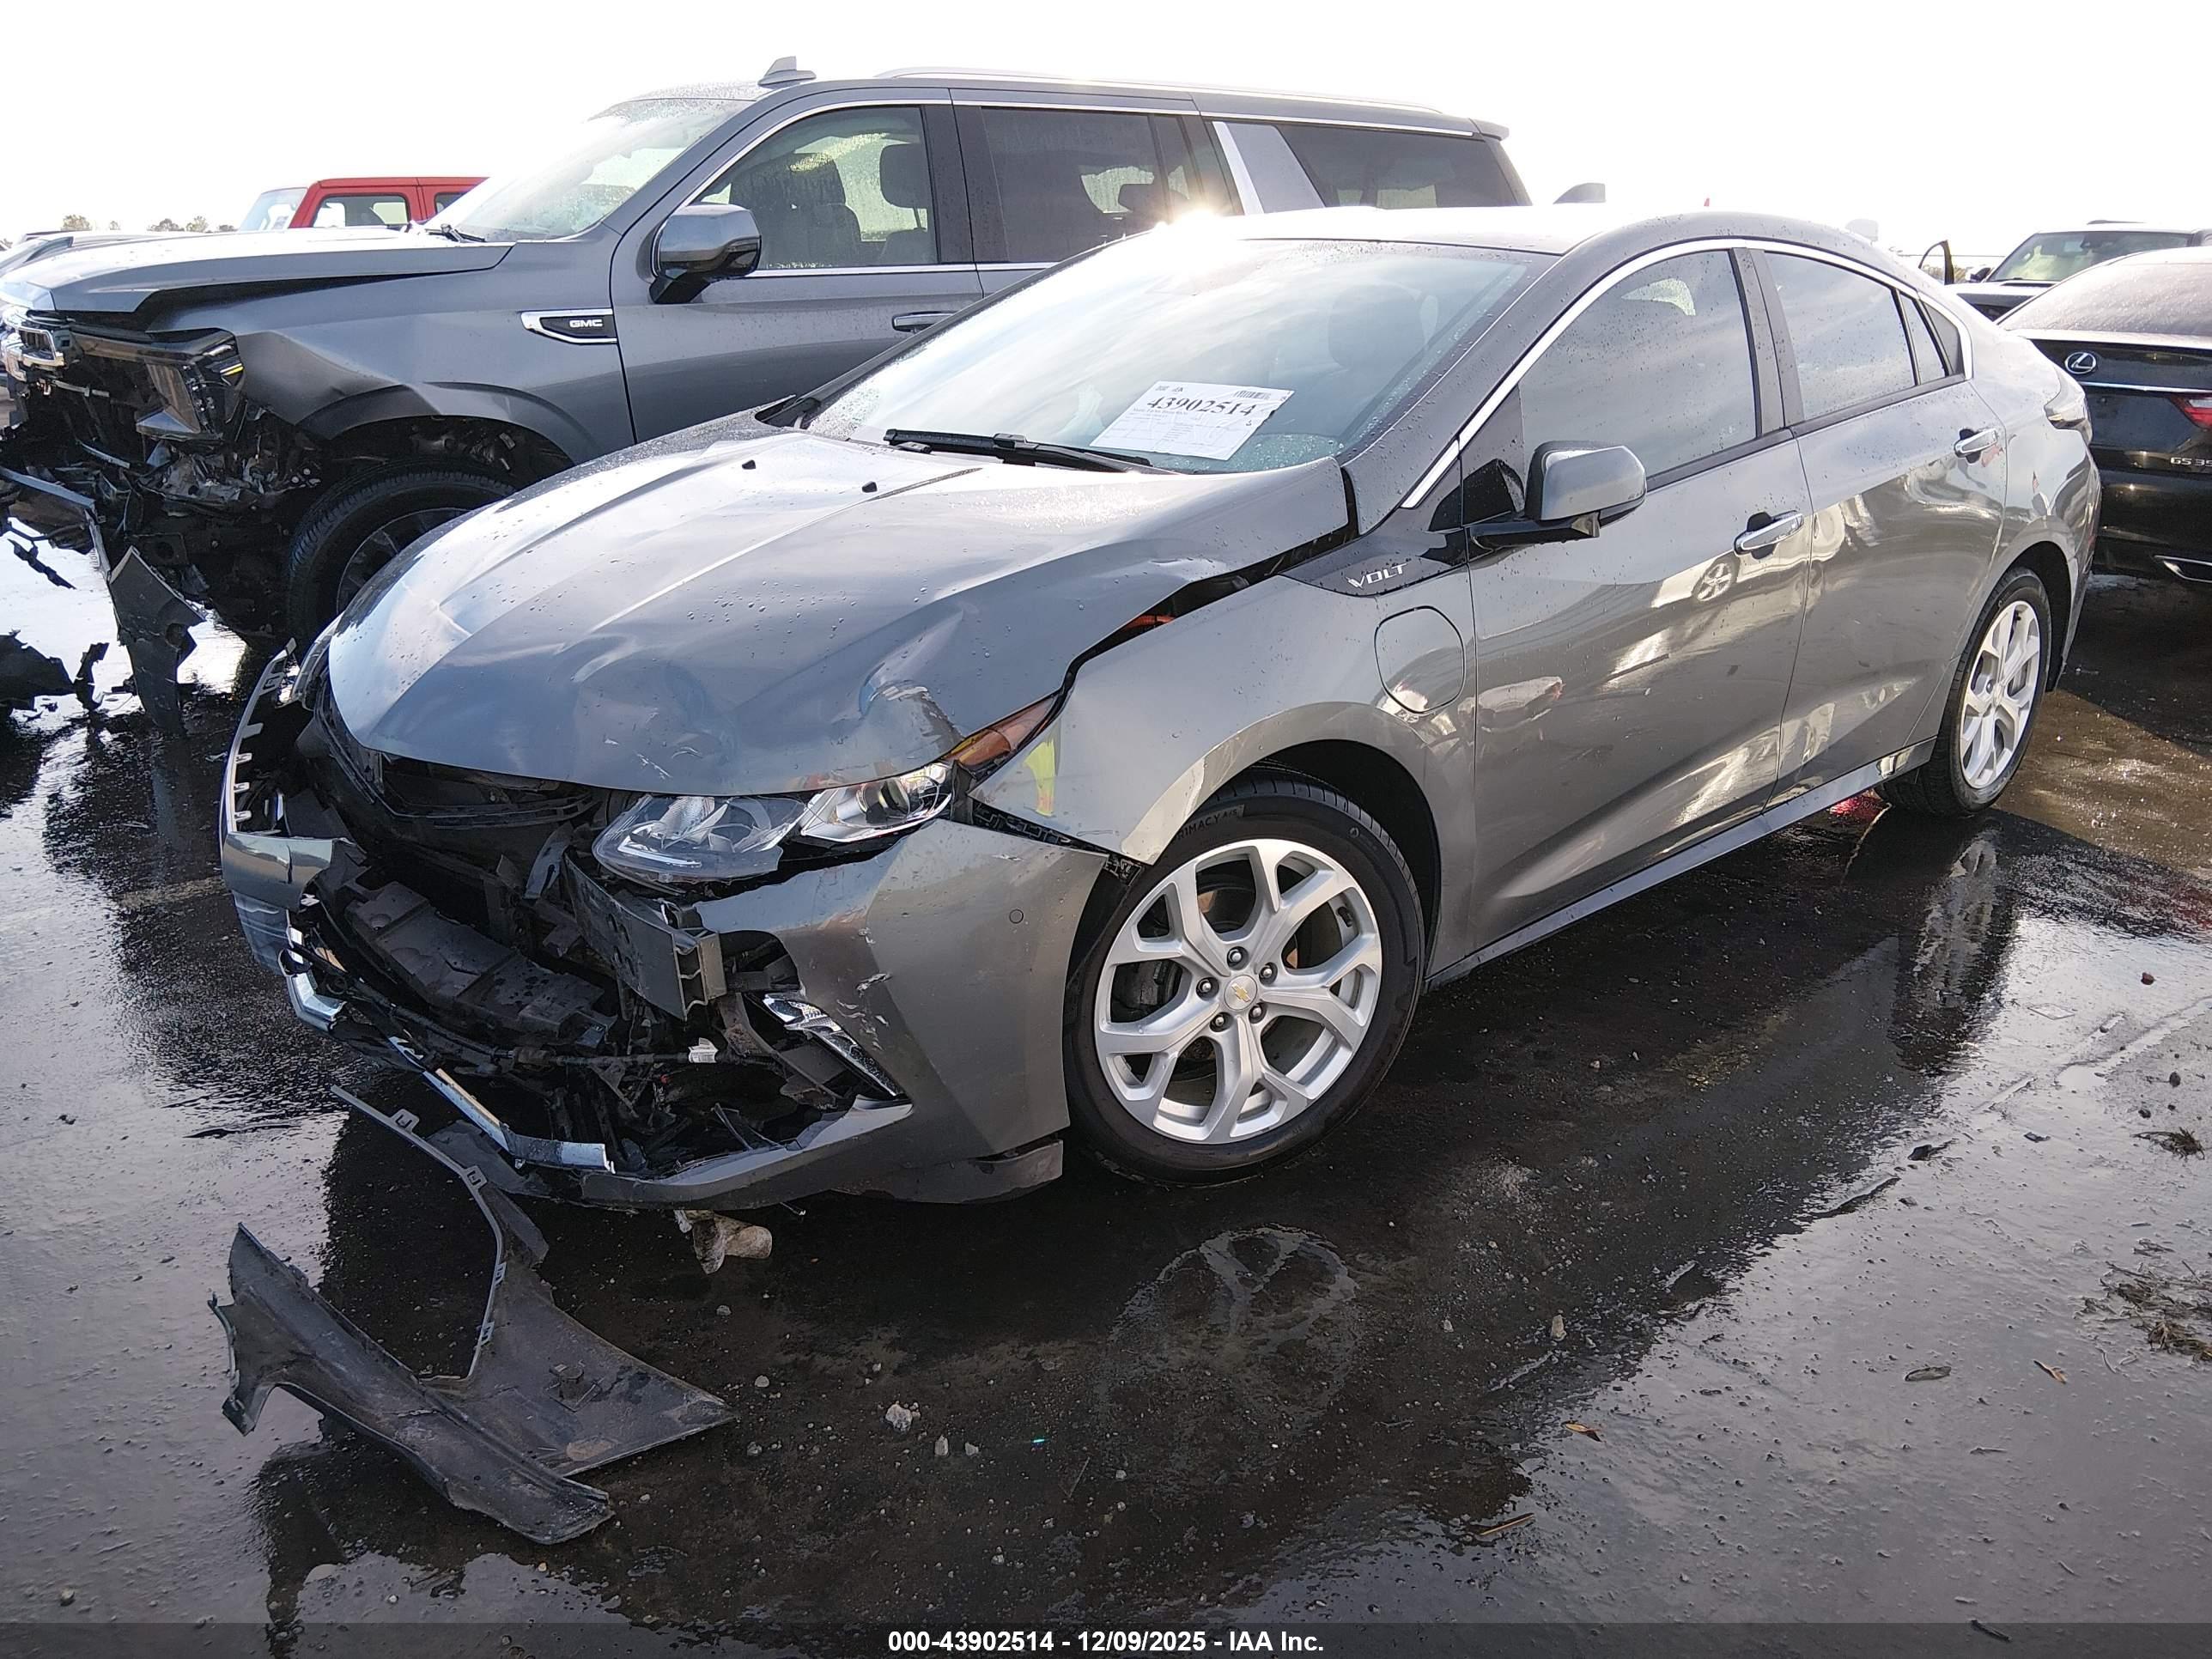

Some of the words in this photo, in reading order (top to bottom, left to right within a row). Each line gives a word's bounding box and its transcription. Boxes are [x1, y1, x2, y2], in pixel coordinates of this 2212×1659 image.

[569, 319, 604, 328] GMC
[1146, 397, 1257, 416] 43902514
[2170, 457, 2192, 465] GS
[1346, 562, 1407, 591] VOLT
[1176, 813, 1220, 841] RIMACY
